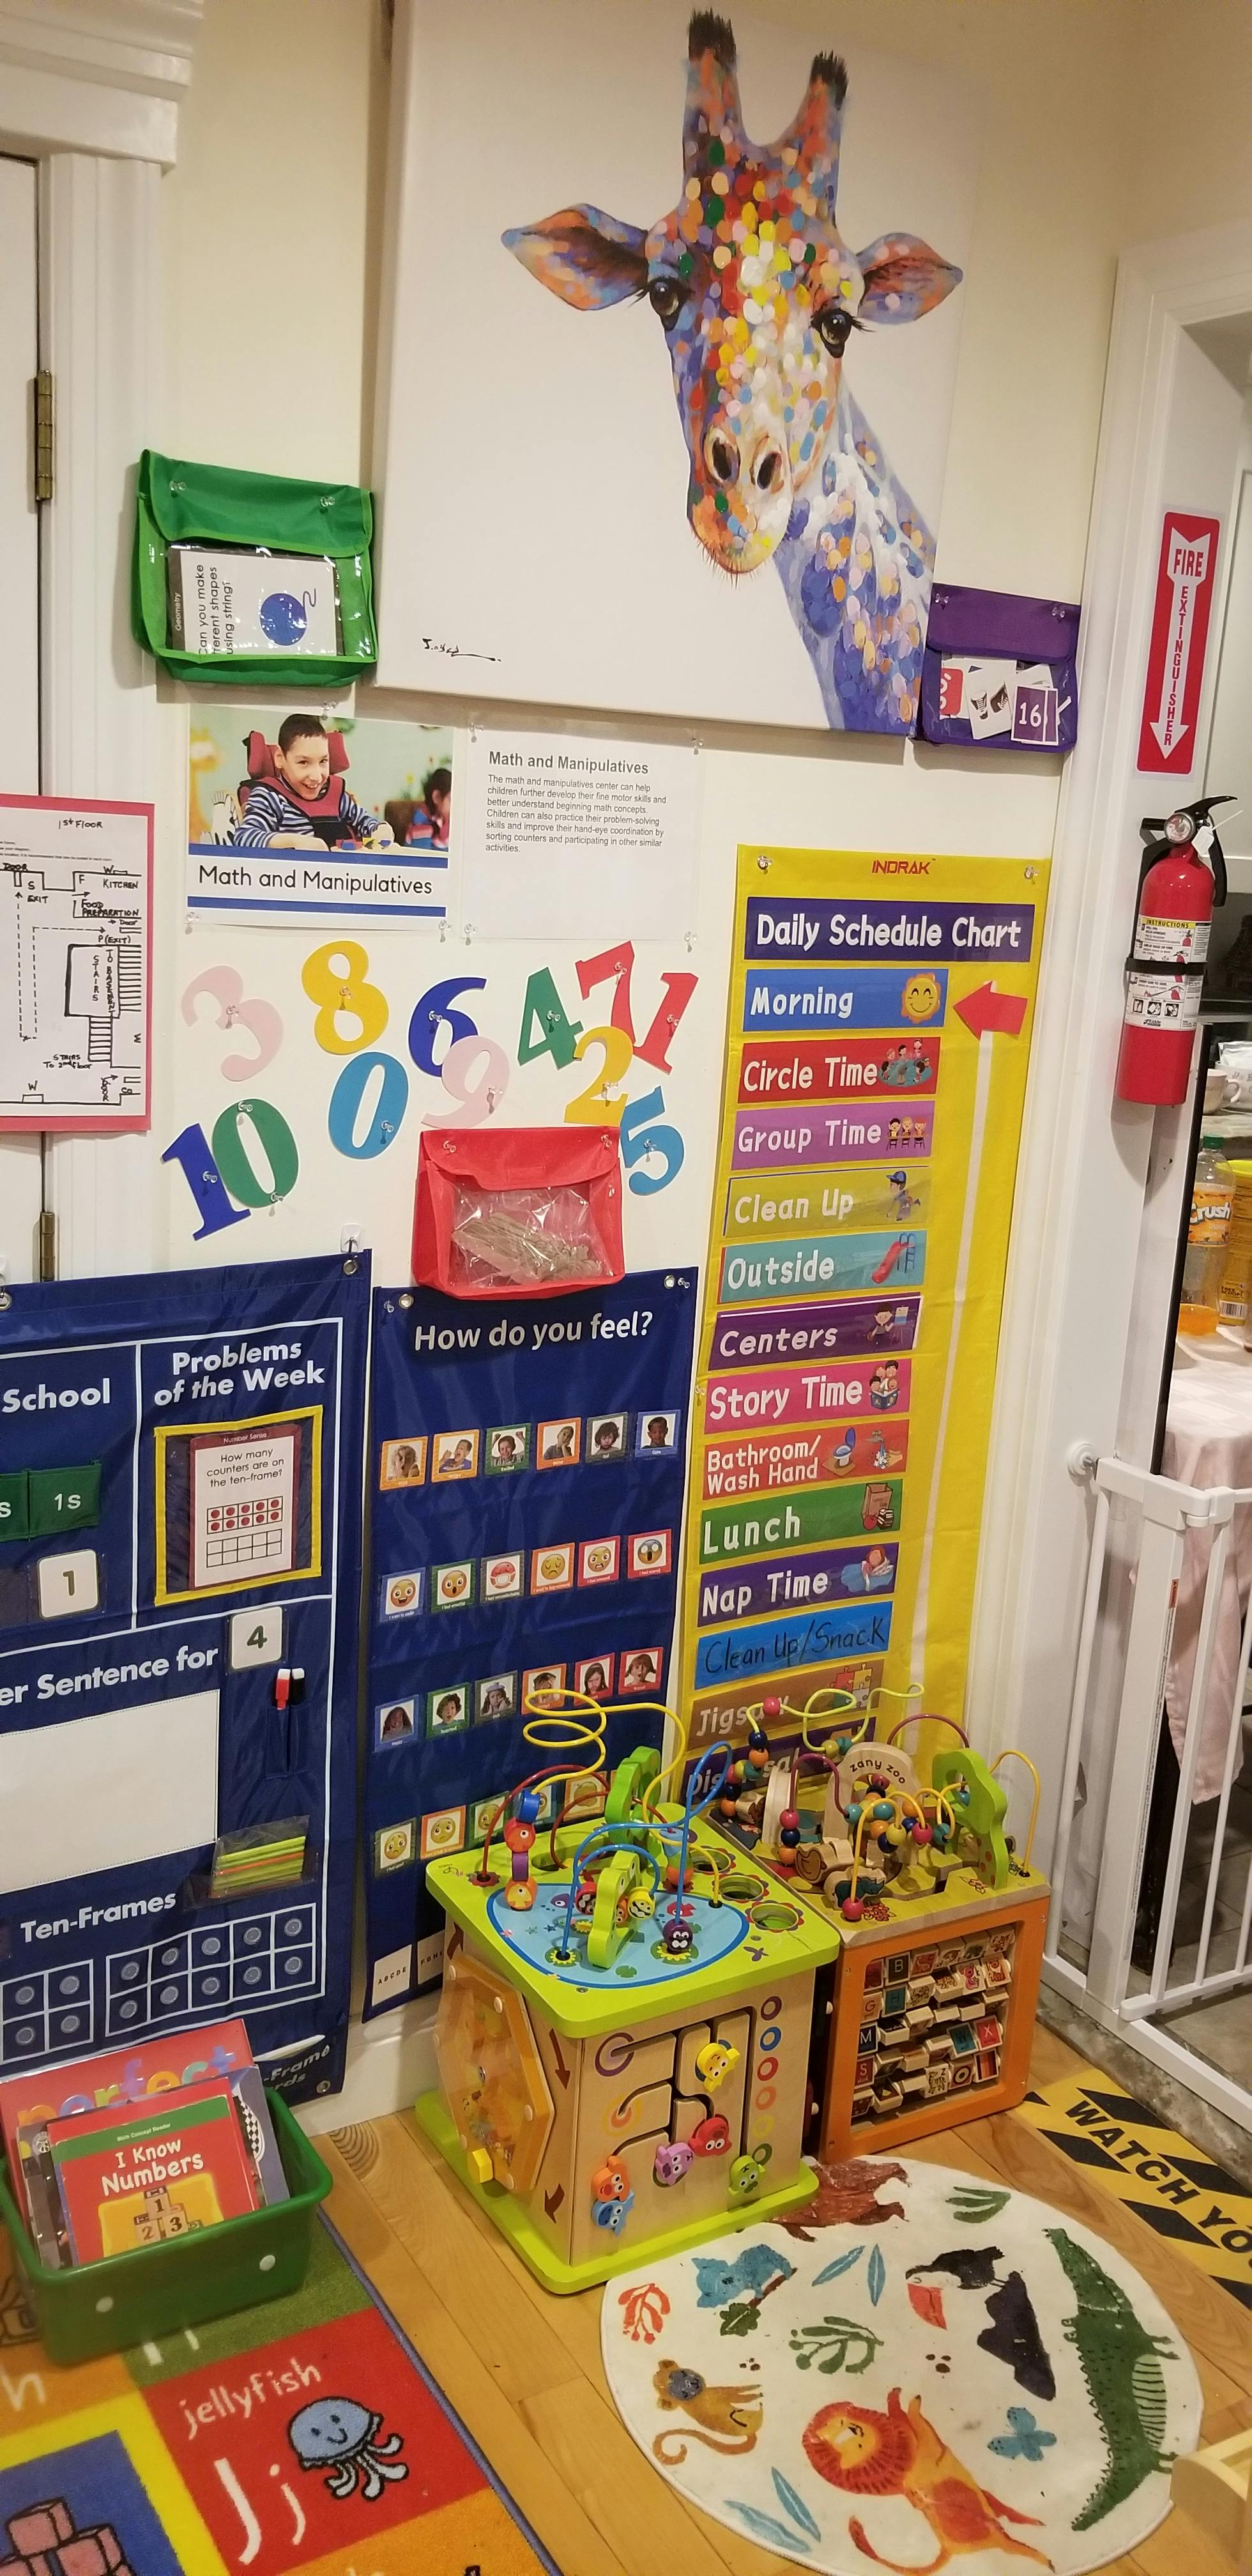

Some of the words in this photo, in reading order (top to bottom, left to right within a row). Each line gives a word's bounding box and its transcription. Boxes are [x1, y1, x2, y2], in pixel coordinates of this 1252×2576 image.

[1173, 548, 1204, 577] FIRE
[195, 564, 206, 599] make
[210, 567, 220, 610] shapes
[199, 604, 208, 627] you
[224, 624, 234, 654] using
[1164, 586, 1189, 746] EXTINGUISHER
[1019, 702, 1041, 727] 16
[489, 751, 523, 766] Math
[528, 755, 553, 768] and
[558, 756, 648, 774] Manipulatives
[487, 787, 517, 795] children
[520, 788, 545, 797] further
[547, 790, 576, 800] develop
[578, 792, 594, 800] their
[634, 795, 651, 803] skills
[489, 774, 503, 783] The
[505, 776, 524, 785] math
[544, 779, 593, 788] manipulatives
[636, 783, 650, 792] help
[487, 798, 509, 806] better
[512, 800, 554, 809] understand
[556, 802, 591, 813] beginning
[614, 806, 647, 815] concepts.
[487, 809, 519, 818] Children
[537, 812, 553, 820] also
[555, 814, 583, 824] practice
[586, 815, 602, 823] their
[604, 816, 660, 827] problem-solving
[59, 818, 73, 829] 1st
[487, 821, 505, 830] skills
[508, 822, 521, 831] and
[524, 824, 554, 832] improve
[574, 825, 607, 835] hand-eye
[610, 827, 653, 836] coordination
[485, 844, 521, 853] activities.
[486, 832, 512, 843] sorting
[565, 837, 608, 847] participating
[79, 875, 85, 884] F
[103, 865, 114, 874] W
[199, 865, 252, 886] Math
[259, 869, 296, 888] and
[303, 871, 432, 895] Manipulatives
[871, 860, 931, 875] INDRAK
[28, 881, 35, 890] S
[103, 878, 139, 889] KITCHEN
[81, 899, 103, 908] FOOD
[82, 908, 139, 917] PREPARATION
[757, 914, 820, 951] Daily
[829, 914, 942, 947] Schedule
[952, 917, 1021, 948] Chart
[1147, 919, 1189, 928] INSTRUCTIONS
[105, 935, 131, 944] (EXIT)
[302, 940, 389, 1055] 8
[575, 940, 636, 1045] 7
[750, 986, 853, 1019] Morning
[181, 965, 284, 1082] 3
[408, 977, 487, 1077] 6
[517, 967, 584, 1071] 4
[632, 972, 699, 1075] 1
[27, 1080, 38, 1091] W
[421, 1035, 510, 1129] 9
[563, 1026, 634, 1127] 2
[744, 1057, 813, 1092] Circle
[825, 1056, 878, 1088] Time
[328, 1052, 409, 1160] 0
[619, 1085, 684, 1196] 5
[738, 1126, 812, 1154] Group
[825, 1119, 881, 1147] Time
[161, 1098, 299, 1241] 10
[735, 1193, 809, 1224] Clean
[822, 1189, 853, 1220] Up
[1189, 1202, 1230, 1223] Crush
[728, 1249, 834, 1290] Outside
[415, 1324, 481, 1351] How
[489, 1319, 525, 1347] do
[532, 1321, 582, 1350] you
[592, 1311, 653, 1339] feel?
[719, 1326, 838, 1357] Centers
[173, 1342, 302, 1375] Problems
[2, 1378, 111, 1413] School
[155, 1384, 184, 1407] of
[192, 1375, 234, 1400] the
[243, 1361, 325, 1392] Week
[709, 1384, 790, 1420] Story
[801, 1375, 862, 1409] Time
[224, 1435, 248, 1444] Number
[707, 1434, 821, 1471] Bathroom/
[207, 1464, 249, 1477] counters
[252, 1461, 268, 1469] are
[221, 1453, 242, 1463] How
[246, 1449, 273, 1459] many
[210, 1478, 226, 1487] the
[230, 1469, 282, 1484] ten-frame?
[706, 1470, 760, 1496] Wash
[768, 1458, 818, 1486] Hand
[54, 1493, 81, 1512] 1s
[703, 1506, 801, 1555] Lunch
[63, 1570, 75, 1596] 1
[702, 1584, 752, 1617] Nap
[767, 1570, 828, 1603] Time
[247, 1625, 268, 1649] 4
[705, 1638, 765, 1675] Clean
[0, 1684, 29, 1706] er
[37, 1657, 170, 1699] Sentence
[176, 1646, 218, 1671] for
[850, 1759, 882, 1772] zany
[886, 1765, 905, 1783] zoo
[20, 1893, 176, 1943] Ten-Frames
[895, 1959, 903, 1972] B
[866, 2000, 876, 2012] G
[860, 2029, 871, 2044] M
[984, 2024, 993, 2037] X
[860, 2064, 867, 2076] S
[131, 2129, 152, 2138] Concept
[153, 2124, 171, 2132] Reader
[115, 2152, 126, 2168] I
[133, 2139, 181, 2164] Know
[101, 2152, 204, 2196] Numbers
[1064, 2100, 1201, 2205] WATCH
[1197, 2205, 1252, 2269] YO
[156, 2199, 165, 2212] 1
[142, 2226, 154, 2241] 2
[170, 2217, 182, 2232] 3
[179, 2358, 321, 2441] jellyfish
